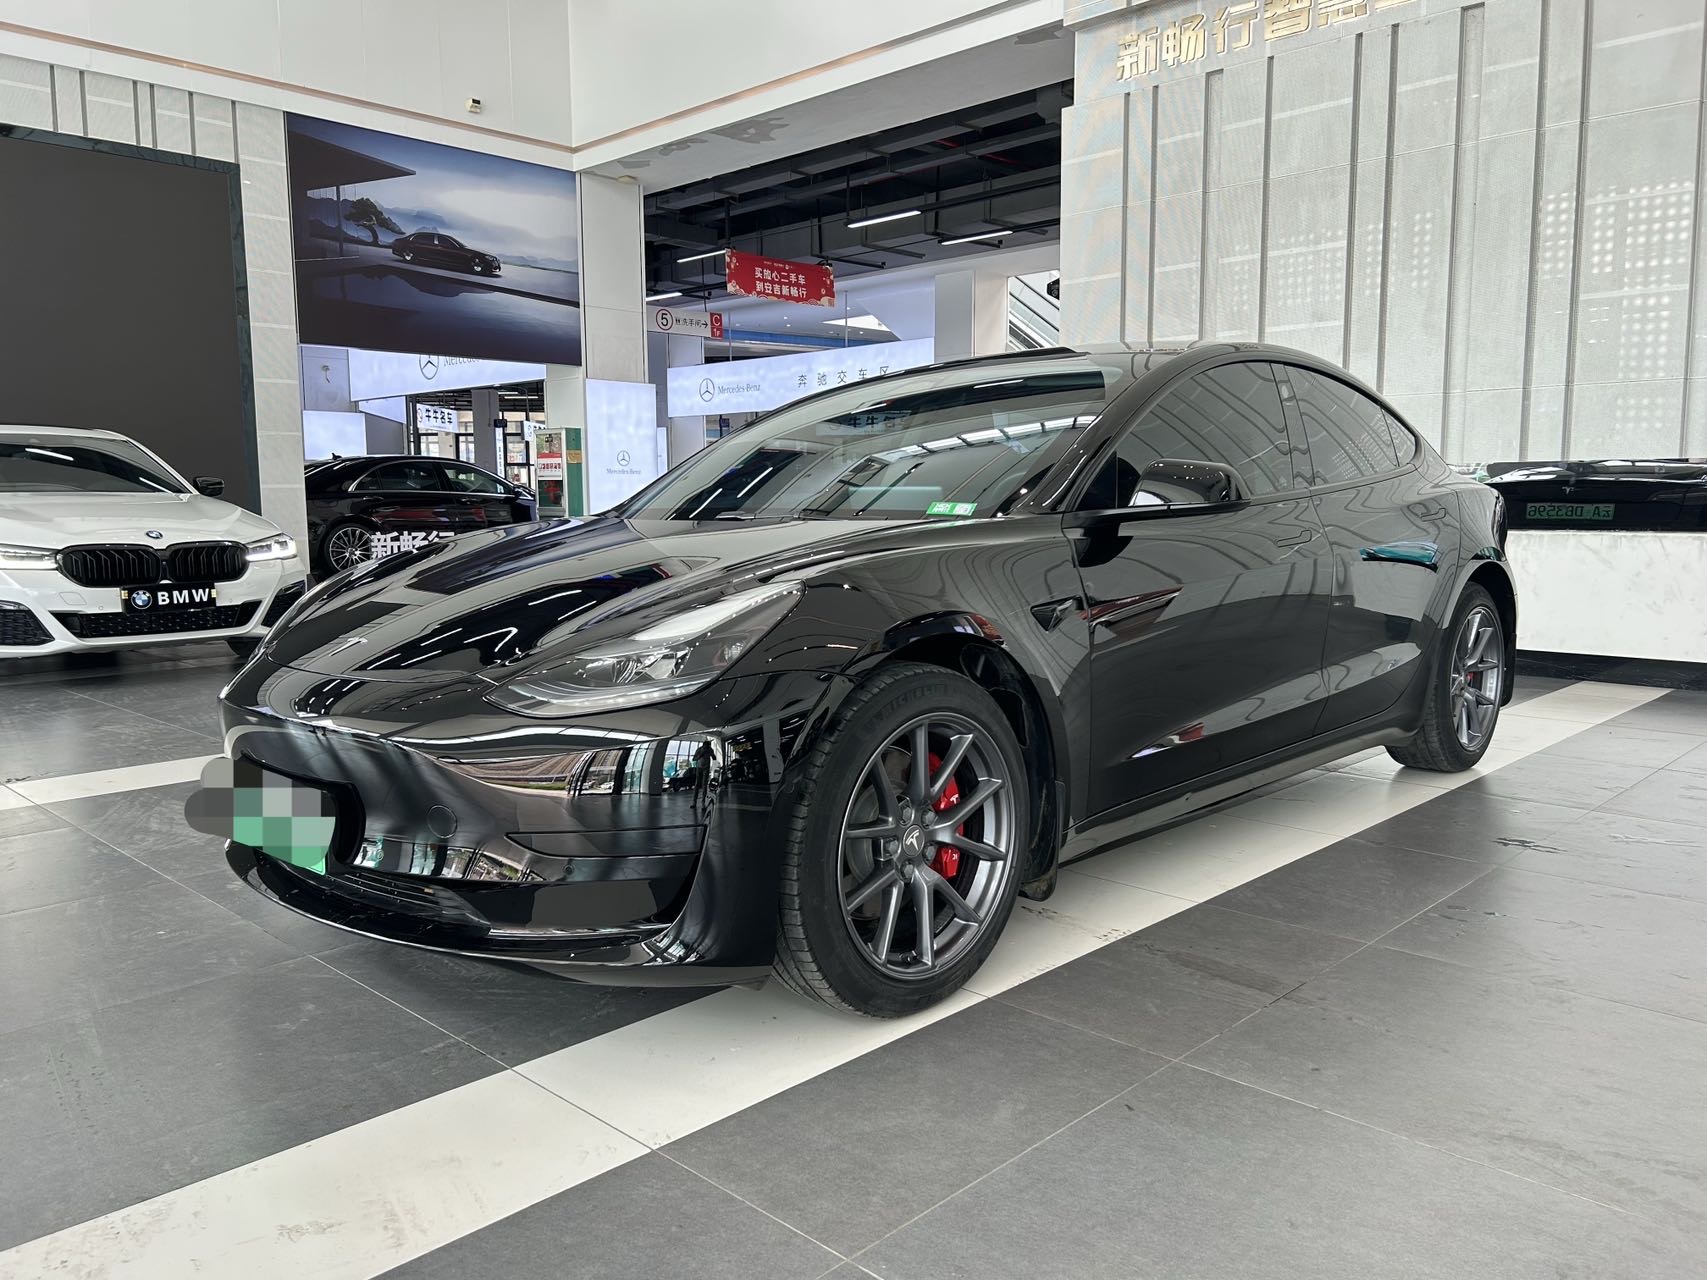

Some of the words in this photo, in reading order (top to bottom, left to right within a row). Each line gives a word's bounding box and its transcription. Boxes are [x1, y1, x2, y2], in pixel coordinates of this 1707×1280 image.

[1116, 0, 1416, 81] 新畅行智
[755, 280, 807, 299] 到安吉新畅行
[682, 318, 702, 328] 洗手间
[712, 314, 721, 326] C
[157, 588, 210, 605] BMW
